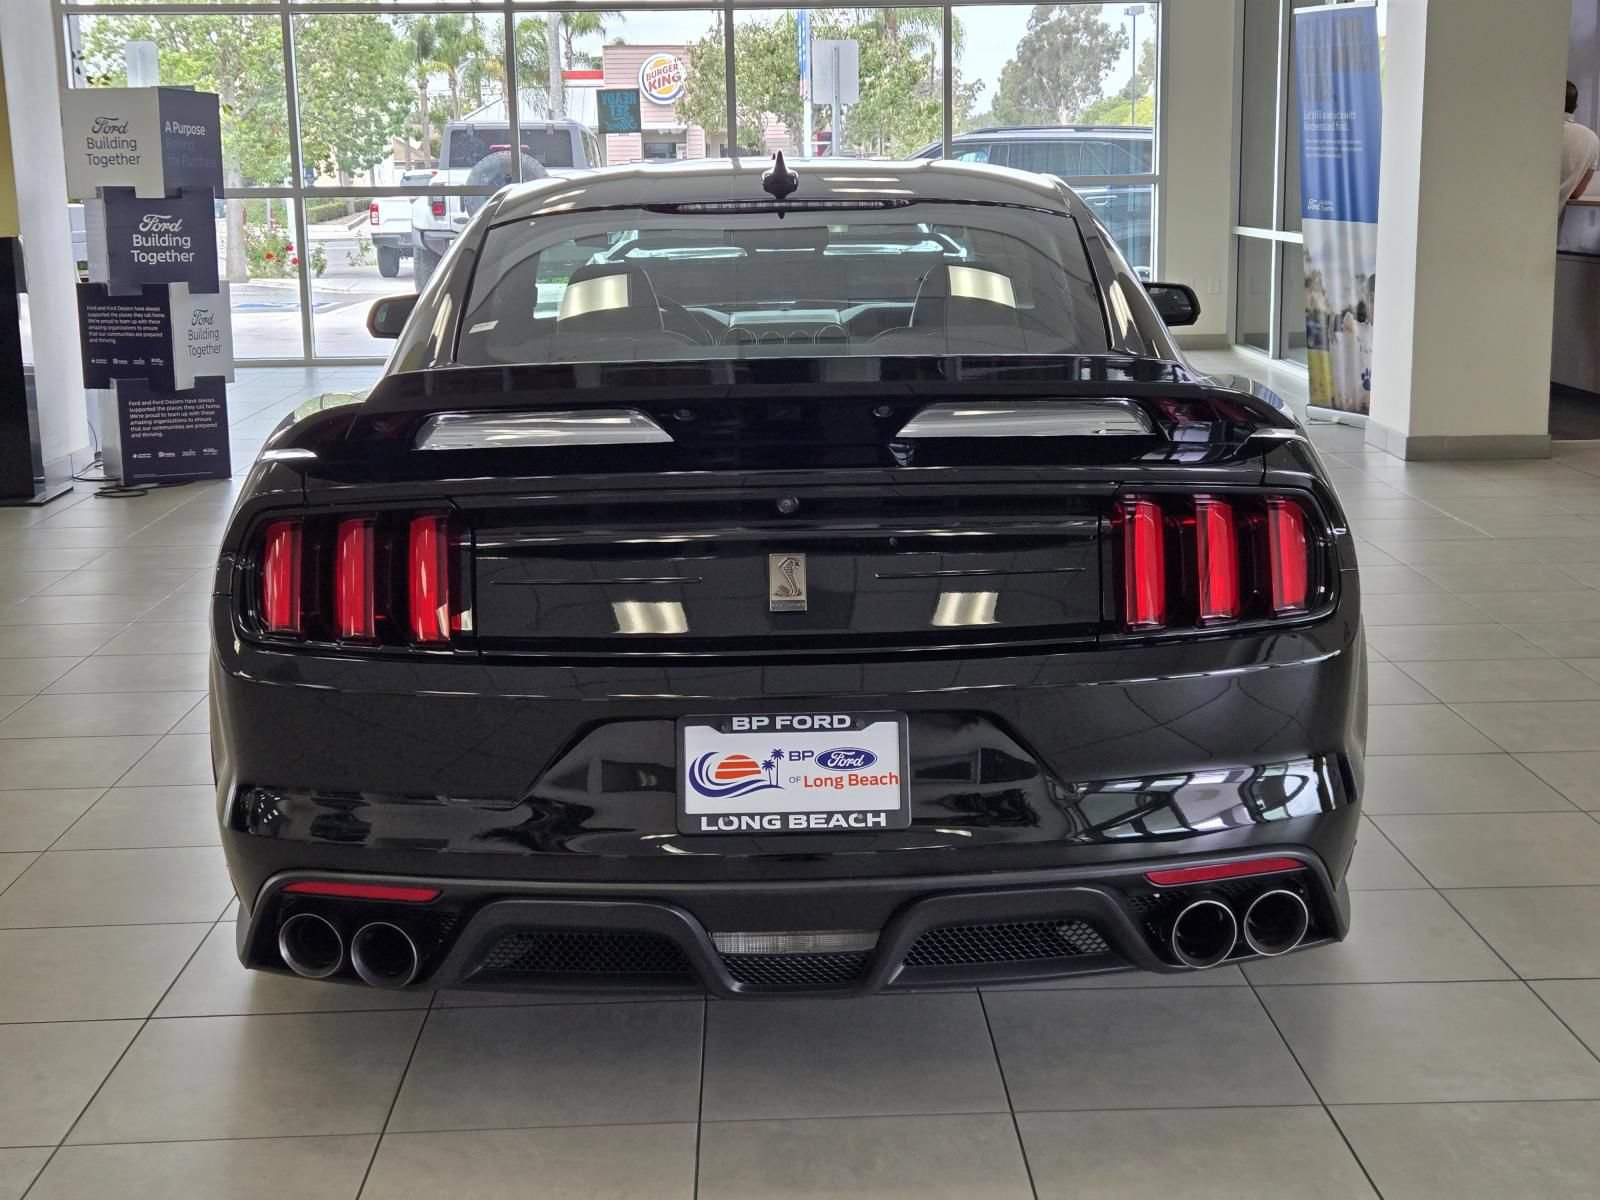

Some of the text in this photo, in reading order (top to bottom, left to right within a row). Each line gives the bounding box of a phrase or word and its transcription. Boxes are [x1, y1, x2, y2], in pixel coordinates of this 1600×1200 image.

[646, 64, 678, 81] BURGER
[648, 72, 681, 92] KING
[91, 116, 128, 134] Ford
[165, 121, 206, 136] A Purpose
[87, 137, 137, 150] Building
[86, 153, 141, 167] Together
[139, 214, 182, 232] Ford
[133, 234, 191, 248] Building
[130, 250, 195, 265] Together
[191, 309, 214, 326] Ford
[188, 327, 219, 341] Building
[188, 343, 222, 358] Together
[732, 715, 850, 730] BP FORD
[789, 751, 864, 767] BP Ford
[789, 772, 898, 790] OF Long Beach
[701, 813, 886, 831] LONG BEACH
